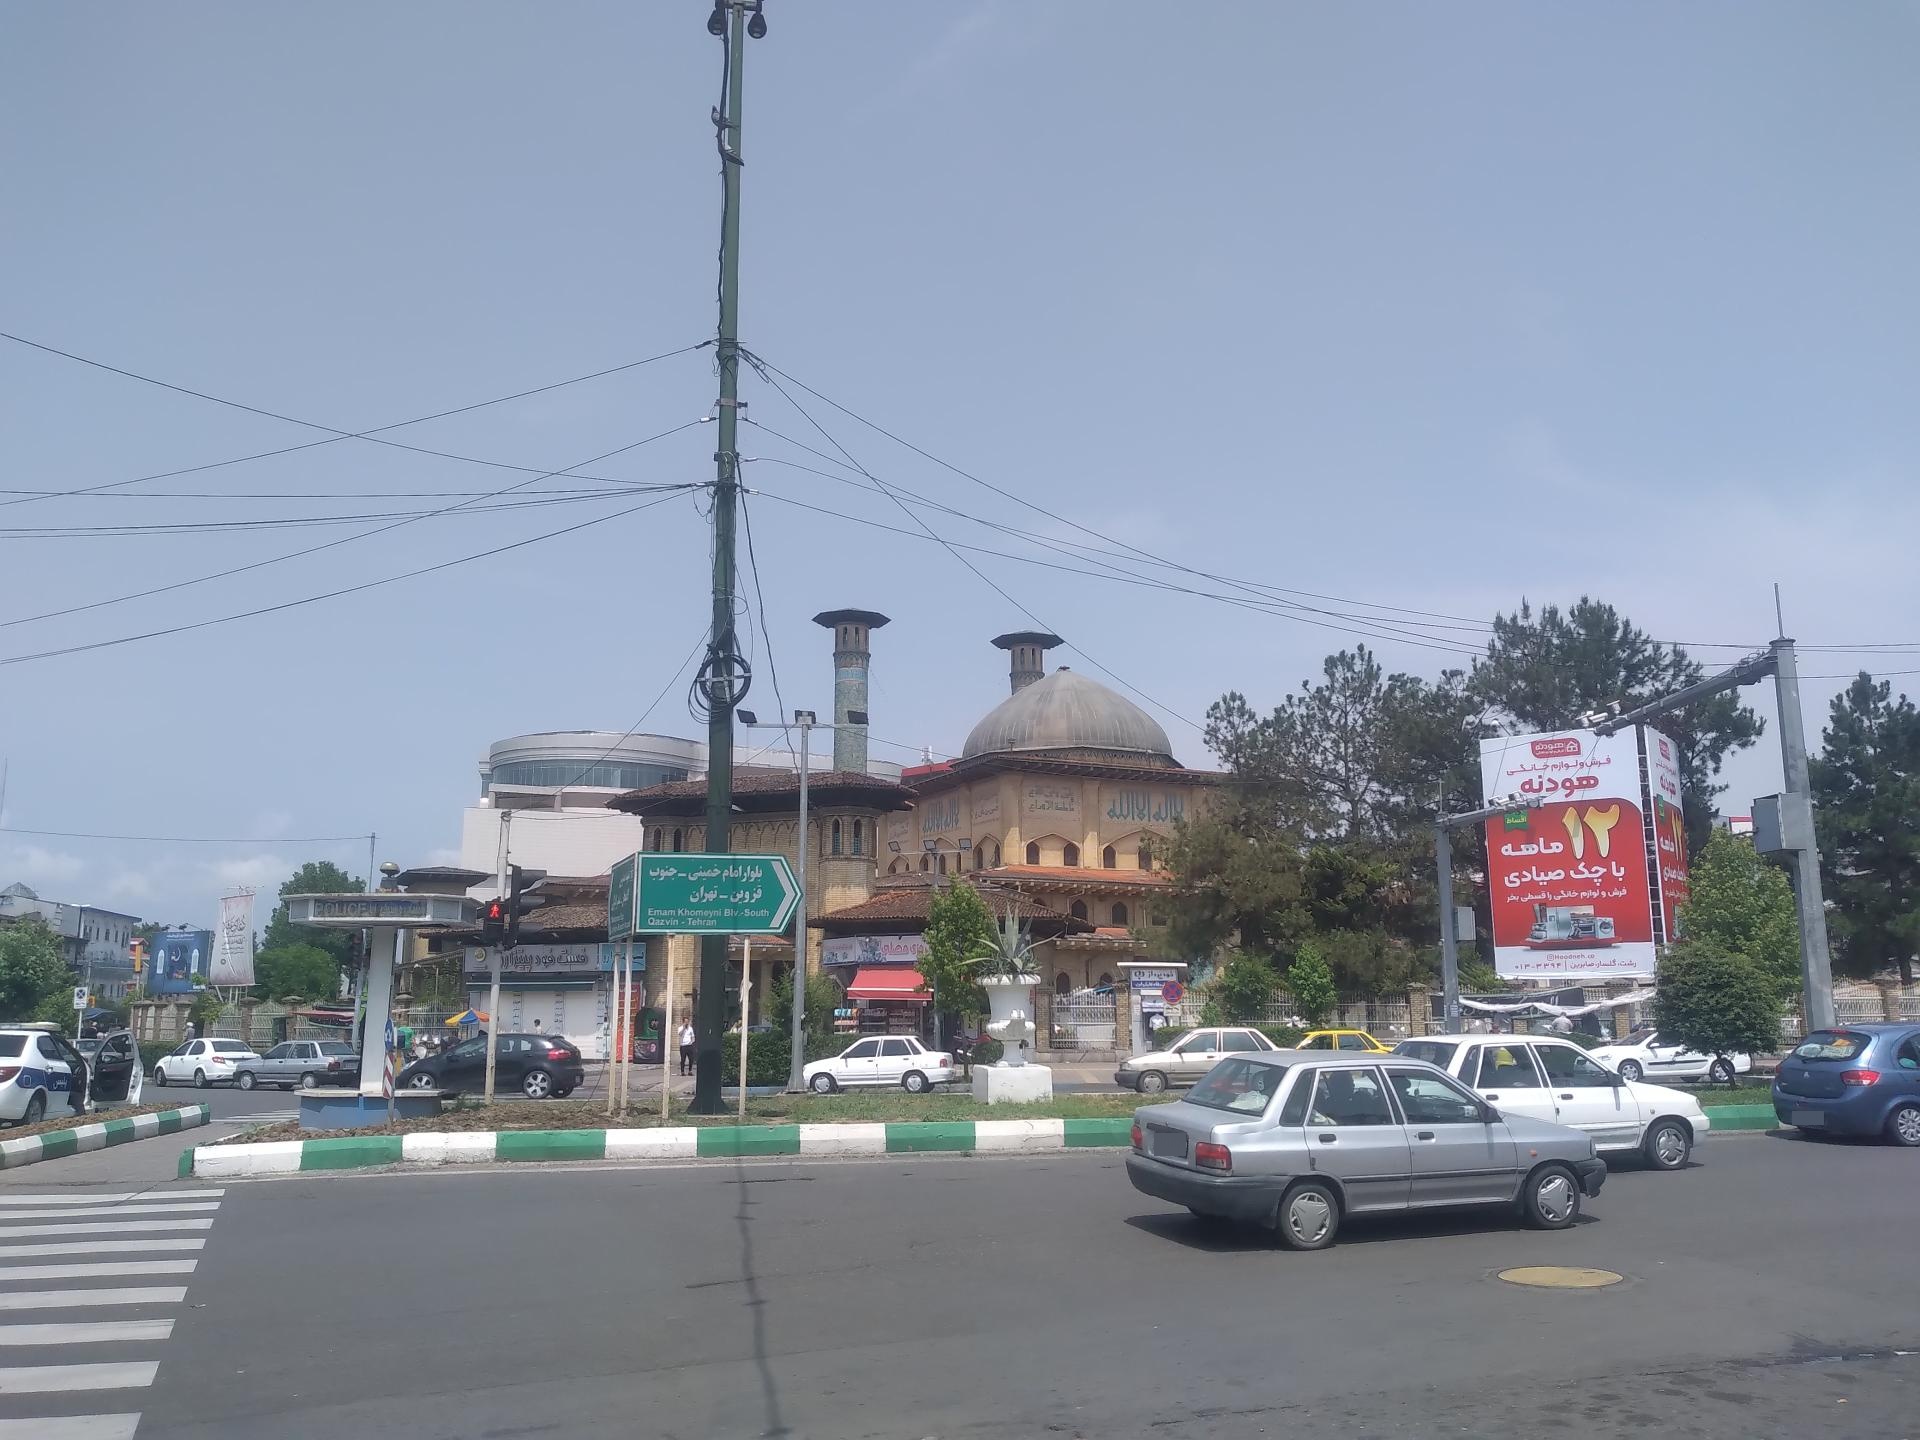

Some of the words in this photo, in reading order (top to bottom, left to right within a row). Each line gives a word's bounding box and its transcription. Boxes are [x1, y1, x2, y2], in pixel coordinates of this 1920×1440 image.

[1520, 775, 1599, 798] هودنه
[1501, 837, 1564, 856] ماهه
[649, 865, 678, 881] جنوب
[688, 864, 721, 881] خمینی
[722, 865, 742, 882] امام
[741, 865, 763, 882] بلوار
[1504, 866, 1566, 888] صیادی
[1569, 862, 1607, 886] چک
[1611, 861, 1625, 881] با
[690, 885, 718, 903] تهران
[730, 885, 763, 904] قزوین
[1506, 895, 1520, 903] بخر
[1520, 891, 1546, 902] قسطی
[1547, 892, 1552, 901] را
[1553, 890, 1578, 901] خانگی
[1580, 889, 1600, 900] لوازم
[1608, 886, 1627, 896] فرش
[648, 908, 676, 917] Emam
[677, 908, 722, 919] Khomeyni
[648, 917, 679, 926] Qazvin
[688, 918, 717, 926] Tehran
[556, 949, 589, 966] فست
